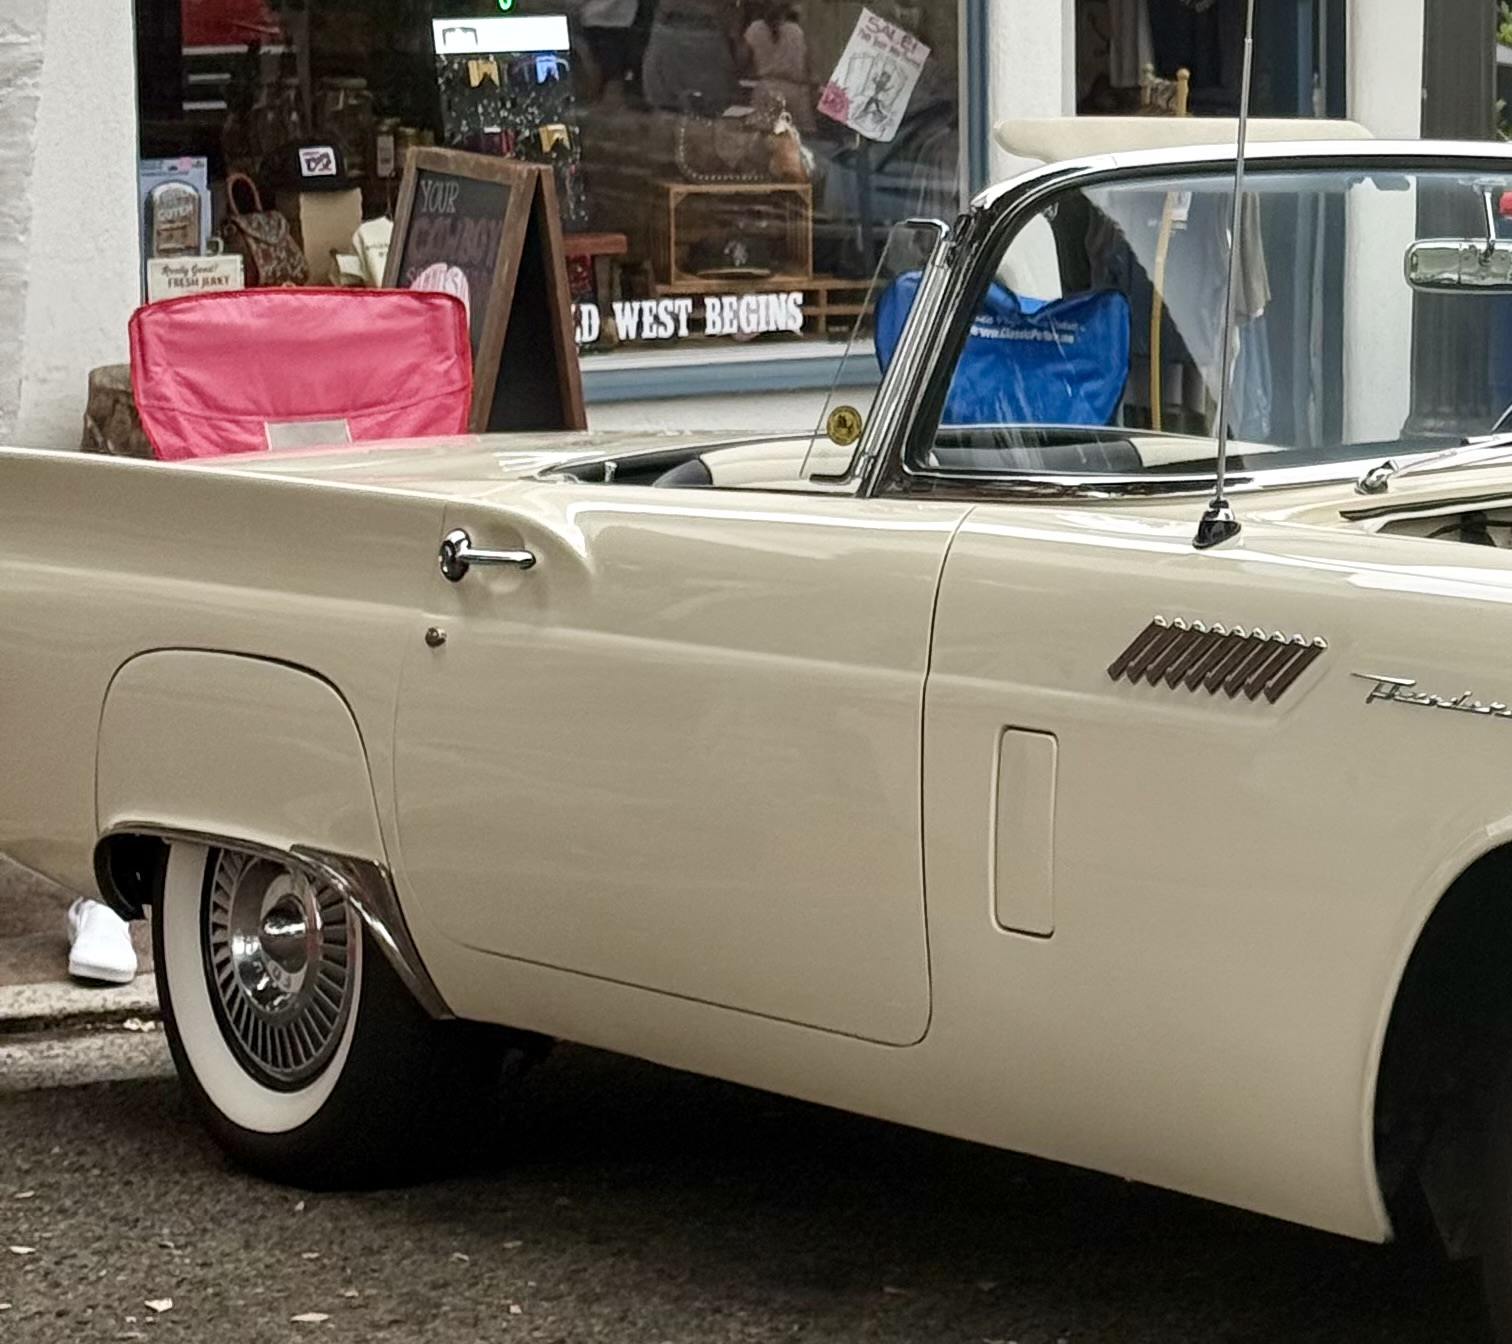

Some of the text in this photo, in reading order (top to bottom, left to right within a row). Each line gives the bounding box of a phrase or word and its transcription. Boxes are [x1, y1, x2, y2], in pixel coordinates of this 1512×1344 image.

[420, 179, 460, 214] YOUR
[167, 273, 231, 289] FRESH JERKY
[612, 296, 693, 341] WEST
[704, 291, 804, 337] BEGINS
